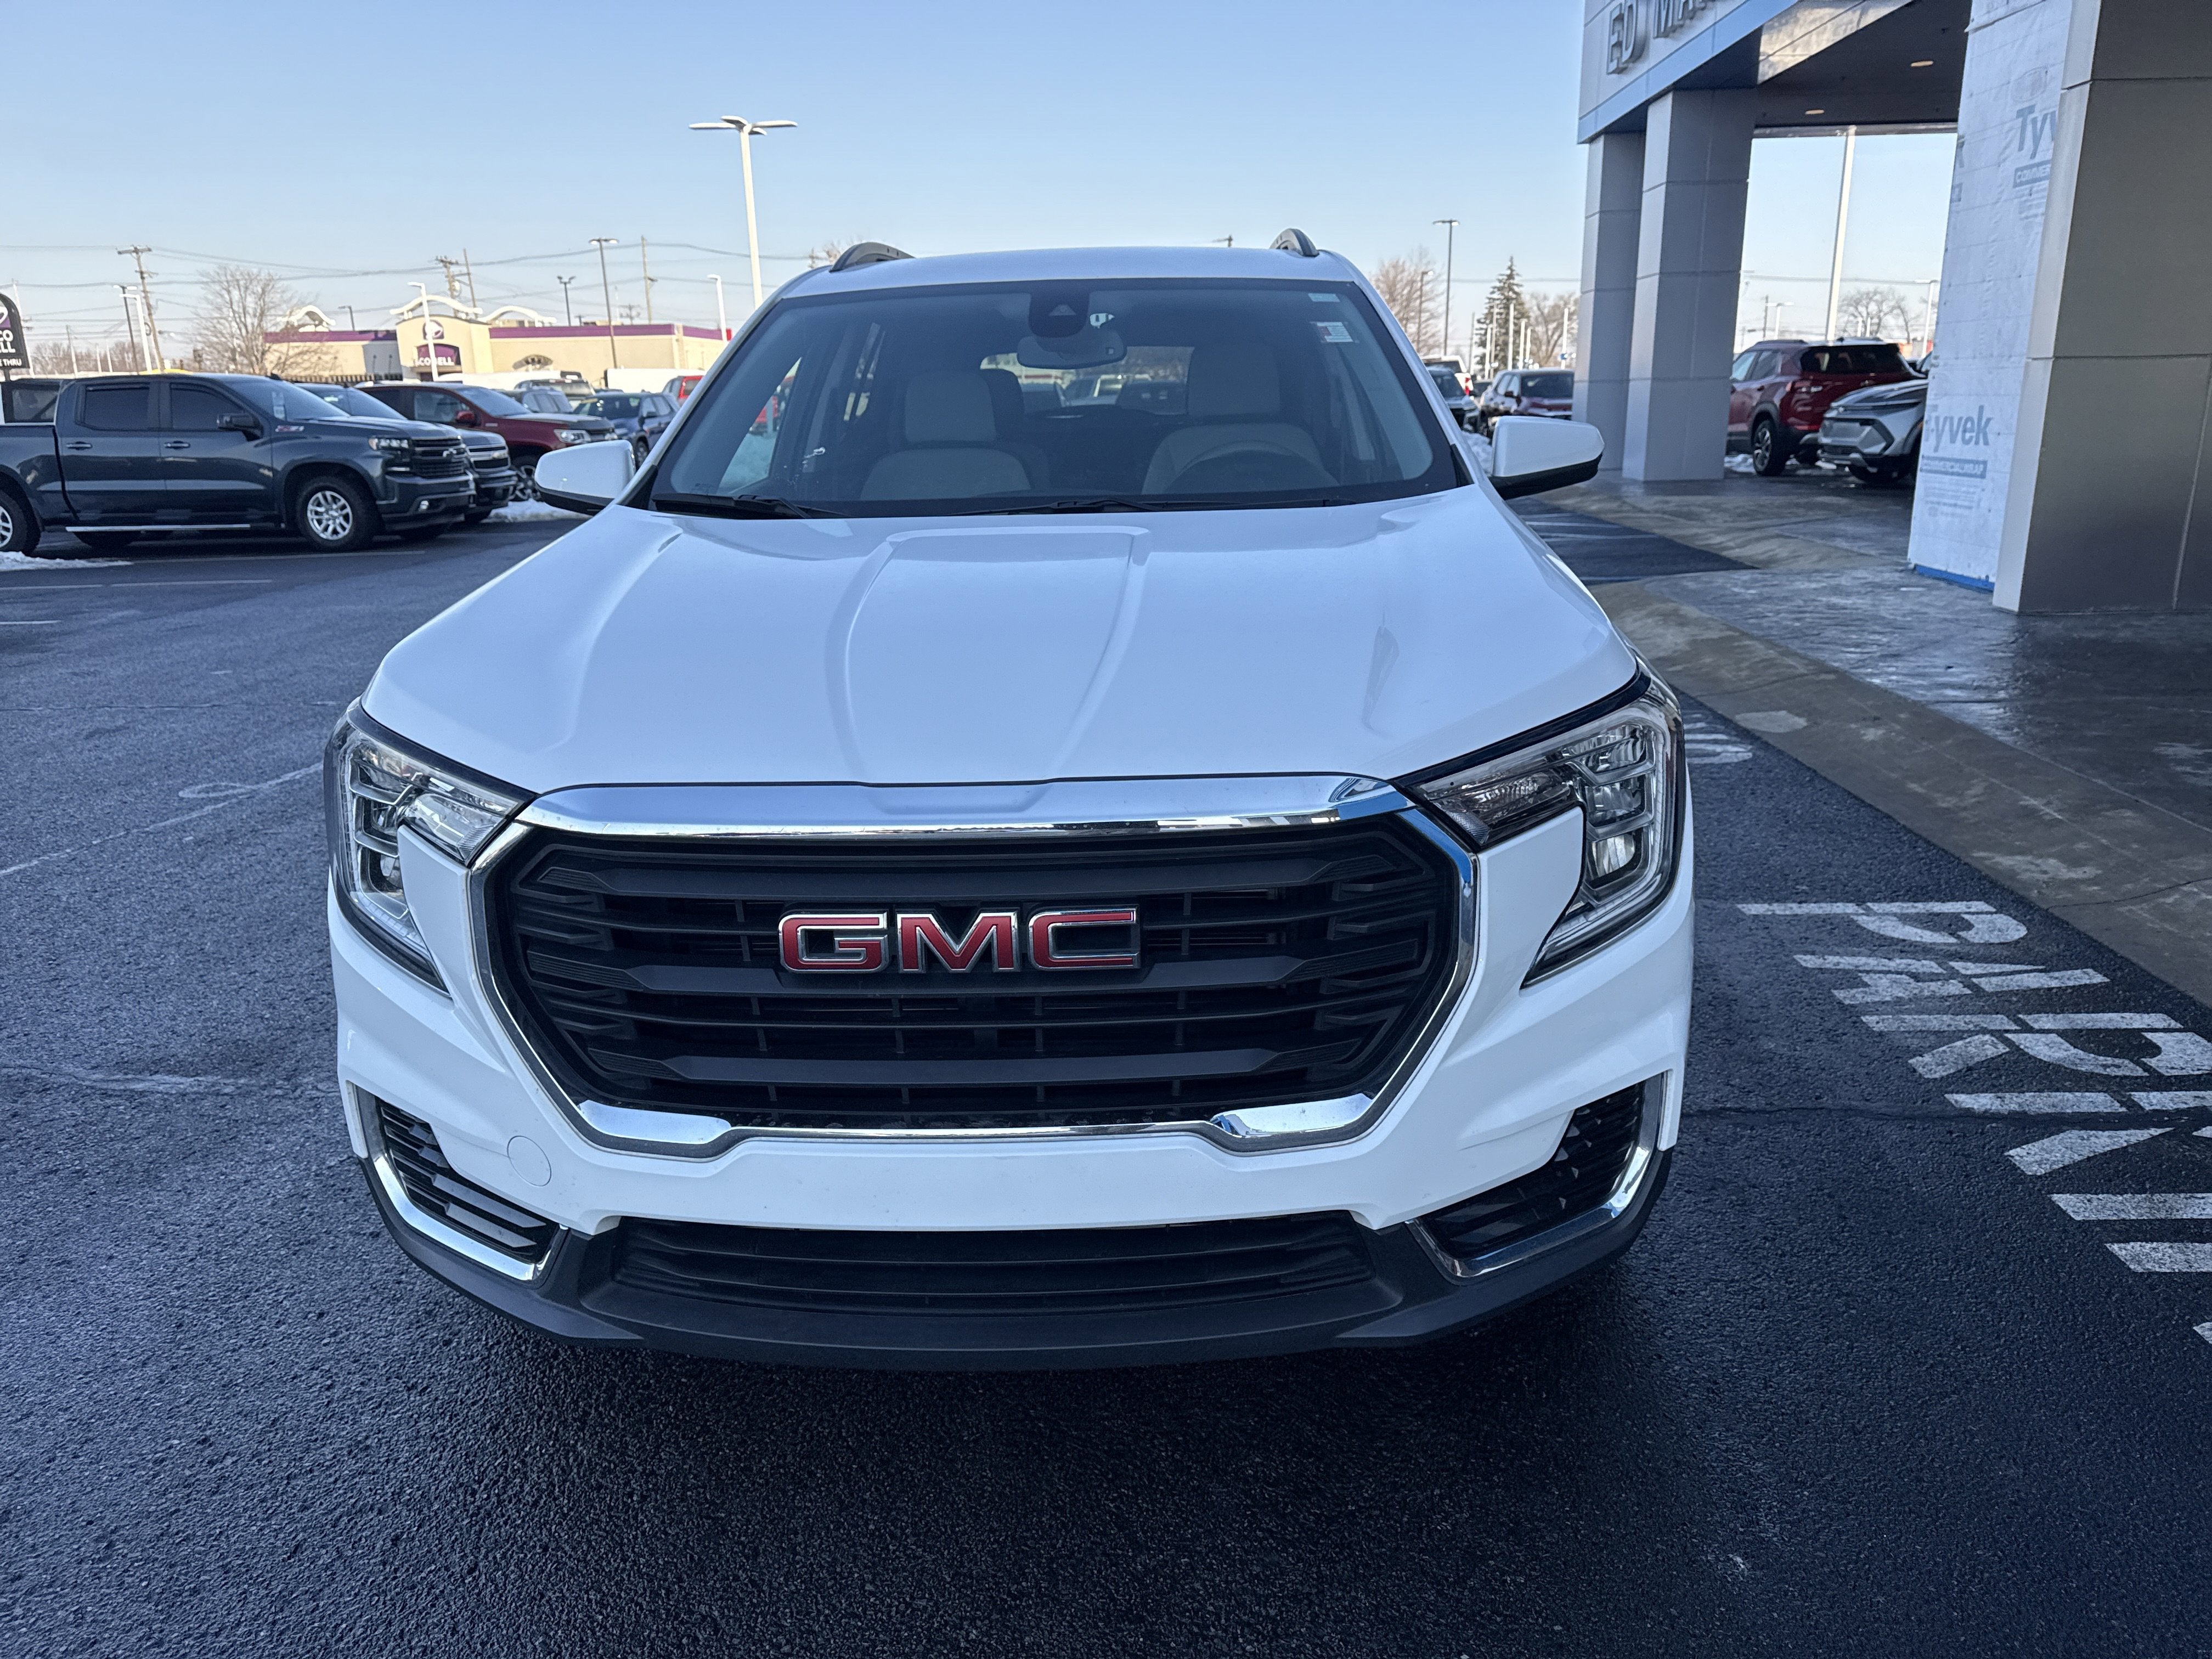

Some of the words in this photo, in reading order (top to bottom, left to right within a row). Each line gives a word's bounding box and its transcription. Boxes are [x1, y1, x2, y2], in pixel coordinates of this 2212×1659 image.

[1606, 0, 1640, 75] ED
[0, 341, 16, 353] LL
[3, 358, 22, 366] THRU
[778, 904, 1141, 974] GMC
[1736, 901, 2212, 1345] PARK
